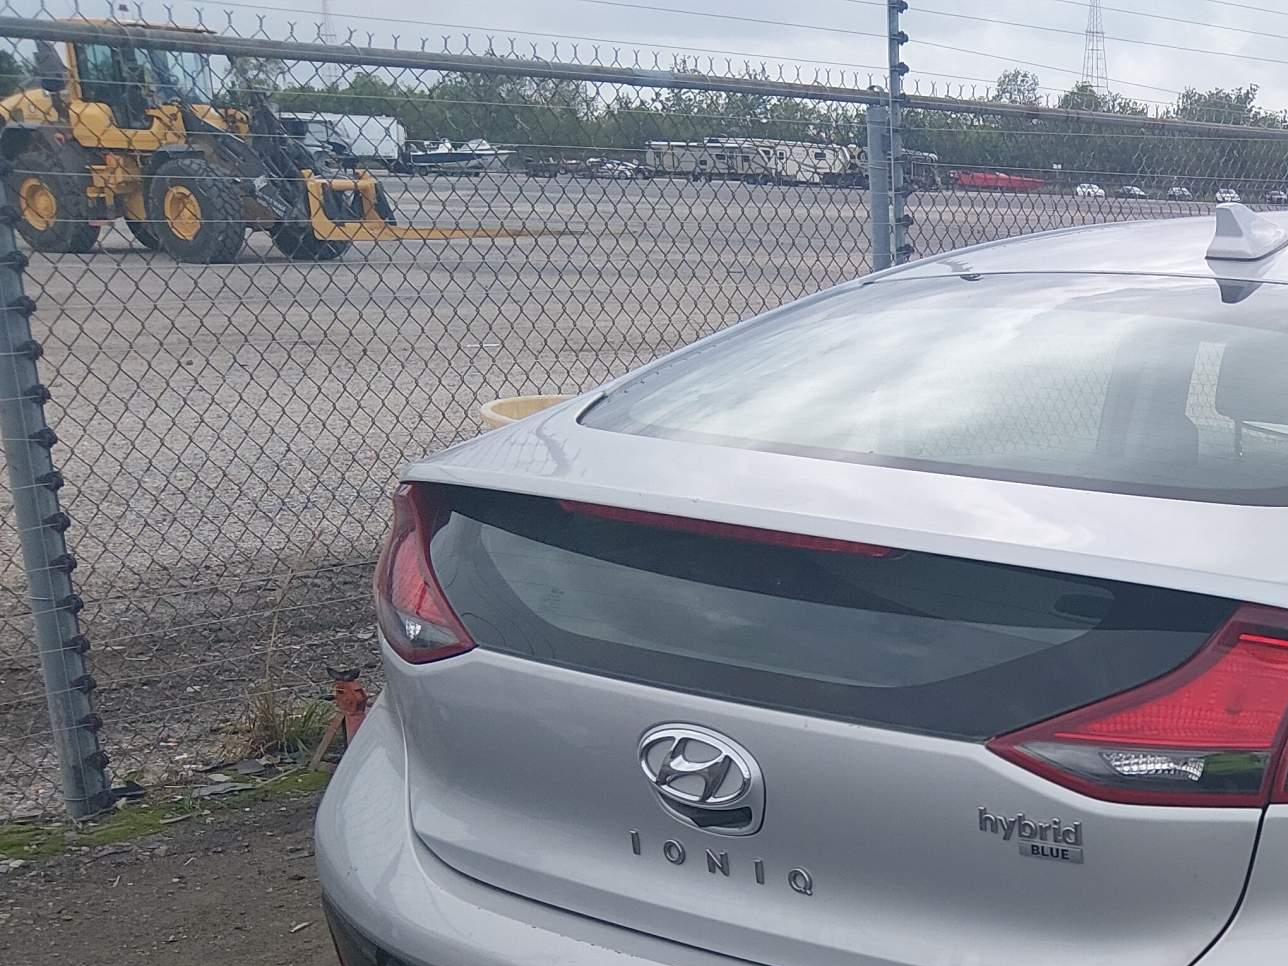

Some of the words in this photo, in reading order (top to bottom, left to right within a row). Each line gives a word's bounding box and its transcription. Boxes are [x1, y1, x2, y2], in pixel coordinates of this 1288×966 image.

[977, 806, 1083, 846] hybrid
[629, 829, 814, 896] IONIQ
[1030, 844, 1071, 861] BLUE
